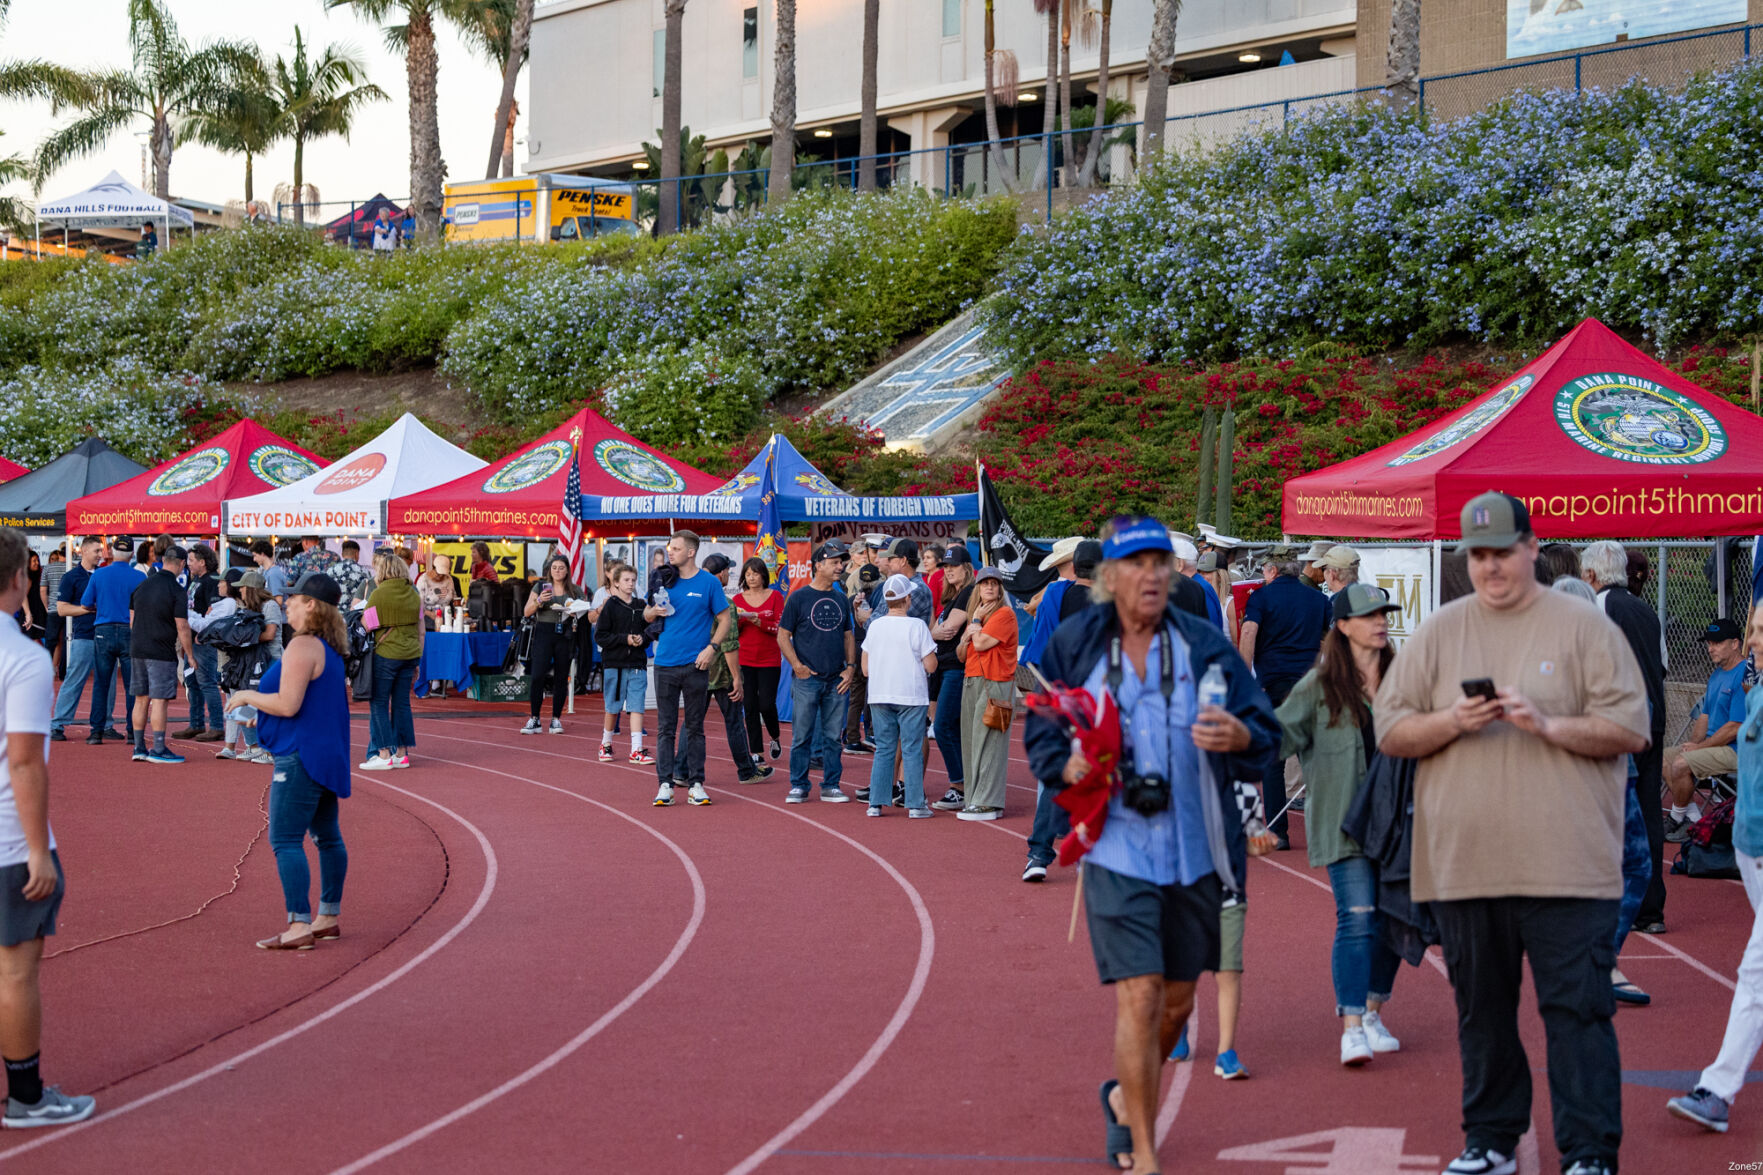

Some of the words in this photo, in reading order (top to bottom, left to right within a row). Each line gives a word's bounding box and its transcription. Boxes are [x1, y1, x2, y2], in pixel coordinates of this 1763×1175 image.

[557, 190, 626, 206] PENSKE
[40, 206, 70, 214] DANA
[74, 203, 104, 212] HILLS
[571, 205, 587, 213] Truck
[590, 206, 611, 215] ental
[1574, 374, 1614, 390] DANA
[1617, 375, 1662, 392] POINT
[1690, 406, 1722, 435] GROUP
[1561, 422, 1607, 454] MARINE
[1612, 451, 1689, 464] REGIMENT
[1690, 436, 1724, 463] SUPPORT
[334, 467, 375, 477] DANA
[326, 477, 368, 487] POINT
[600, 497, 613, 513] NO
[614, 497, 629, 512] ONE
[631, 496, 652, 512] DOES
[654, 495, 678, 512] MORE
[680, 496, 697, 512] FOR
[698, 496, 743, 513] VETERANS
[804, 497, 859, 516] VETERANS
[862, 497, 875, 515] OF
[878, 497, 921, 515] FOREIGN
[923, 497, 955, 515] WARS
[1296, 489, 1424, 519] danapoint5thmarines.com
[4, 517, 23, 526] Police
[25, 517, 54, 526] Services
[79, 509, 208, 526] danapoint5thmarines.com
[232, 513, 260, 527] CITY
[264, 512, 280, 527] OF
[285, 512, 321, 526] DANA
[326, 511, 367, 526] POINT
[403, 508, 558, 525] danapoint5thmarines.com
[815, 523, 846, 542] JOIN
[933, 522, 955, 538] OF
